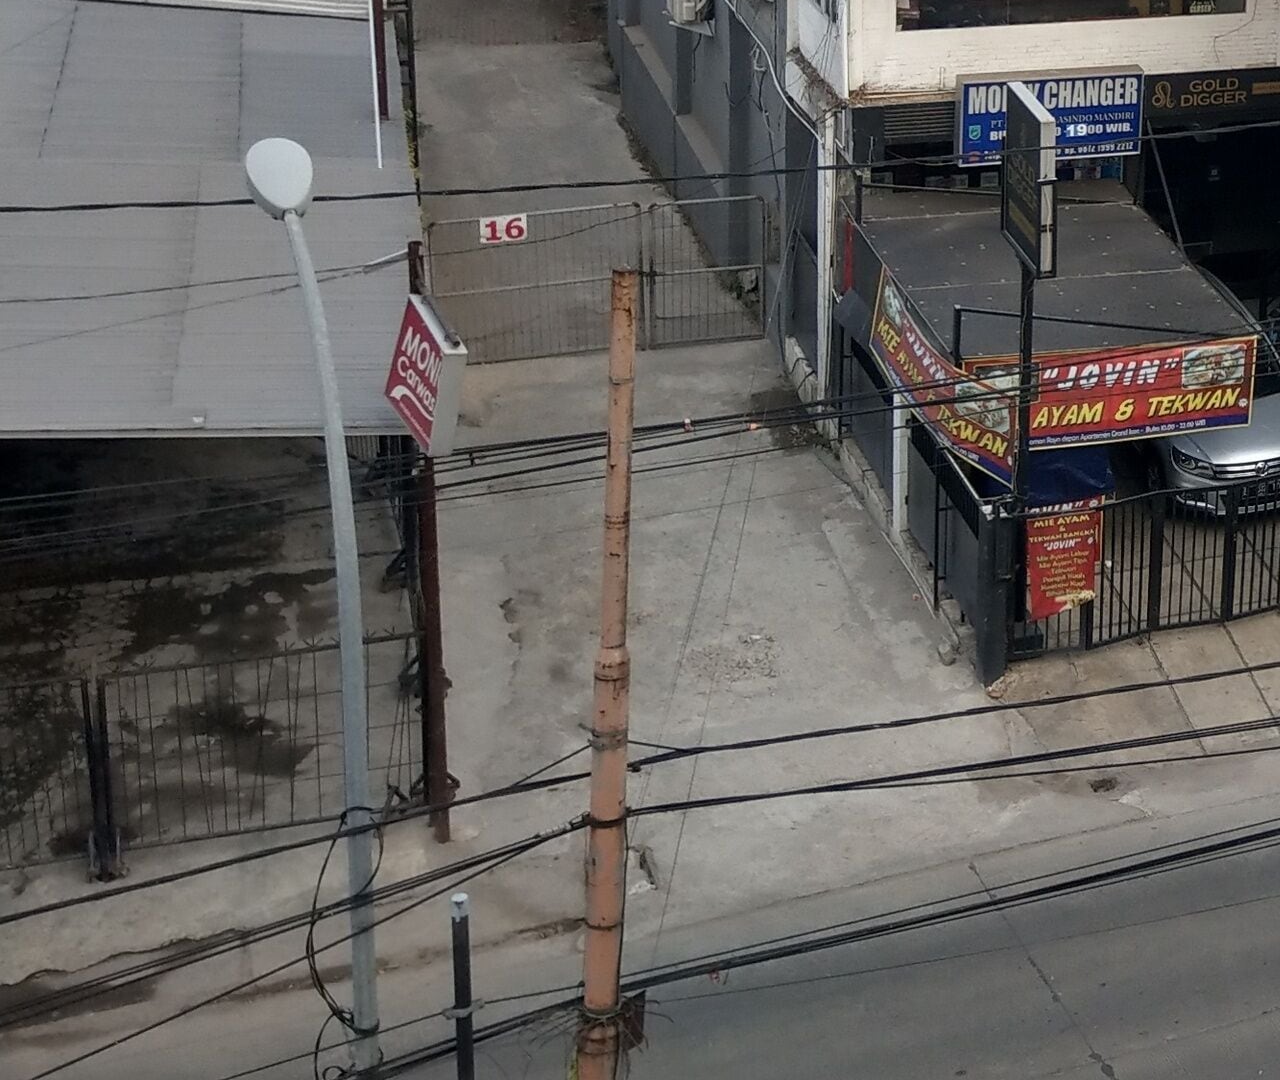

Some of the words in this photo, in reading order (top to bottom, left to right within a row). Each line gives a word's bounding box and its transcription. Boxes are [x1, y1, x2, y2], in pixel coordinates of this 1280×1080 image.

[1189, 78, 1239, 92] GOLD
[967, 82, 1044, 115] MOY
[1044, 77, 1138, 109] CHANGER
[1180, 91, 1247, 107] DIGGER
[1093, 111, 1135, 121] MANDIRI
[1105, 122, 1133, 133] WIB.
[485, 217, 525, 241] 16
[397, 356, 436, 412] Carwas
[1032, 401, 1105, 429] AYAM
[1114, 398, 1135, 421] &
[1148, 388, 1242, 417] TEKWAN
[1034, 518, 1055, 528] MIE
[1057, 514, 1090, 525] AYAM
